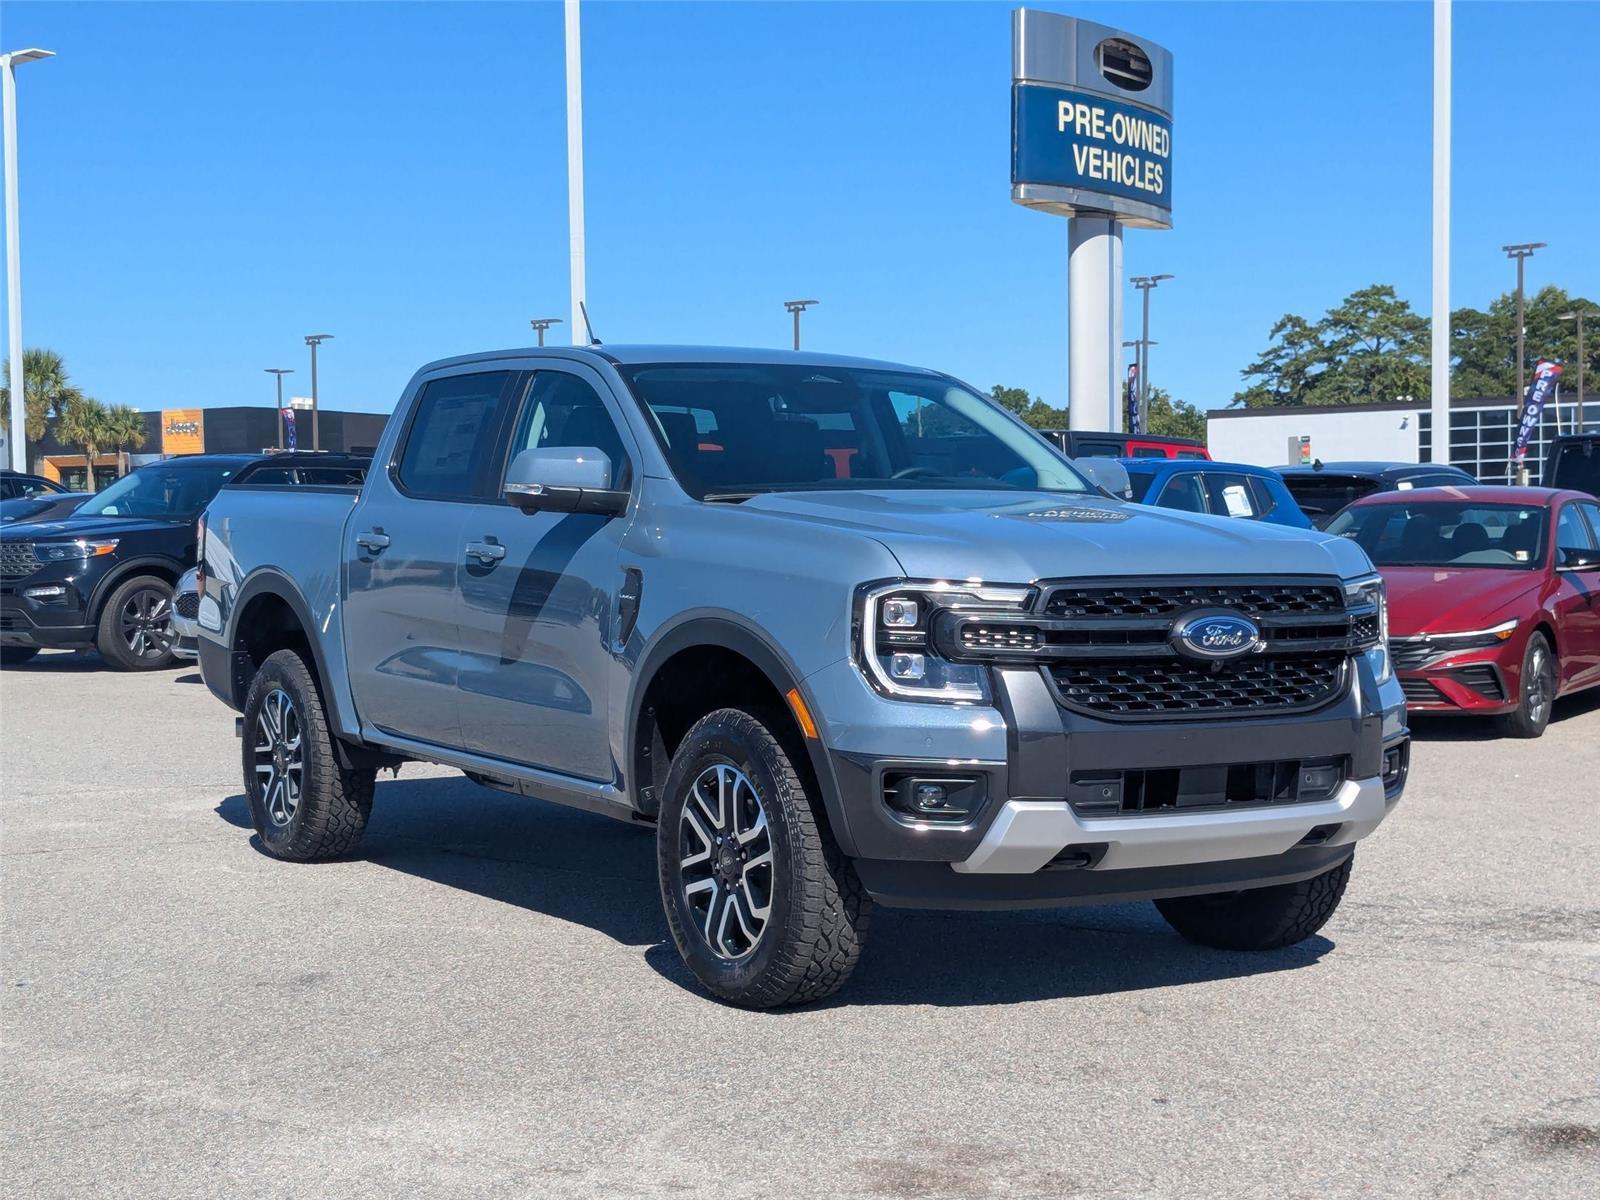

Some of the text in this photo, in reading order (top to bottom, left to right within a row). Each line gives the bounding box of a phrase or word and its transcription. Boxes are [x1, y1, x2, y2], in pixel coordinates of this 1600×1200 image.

[1058, 100, 1170, 158] PRE-OWNED
[1072, 144, 1163, 194] VEHICLES
[1202, 624, 1242, 646] Ford
